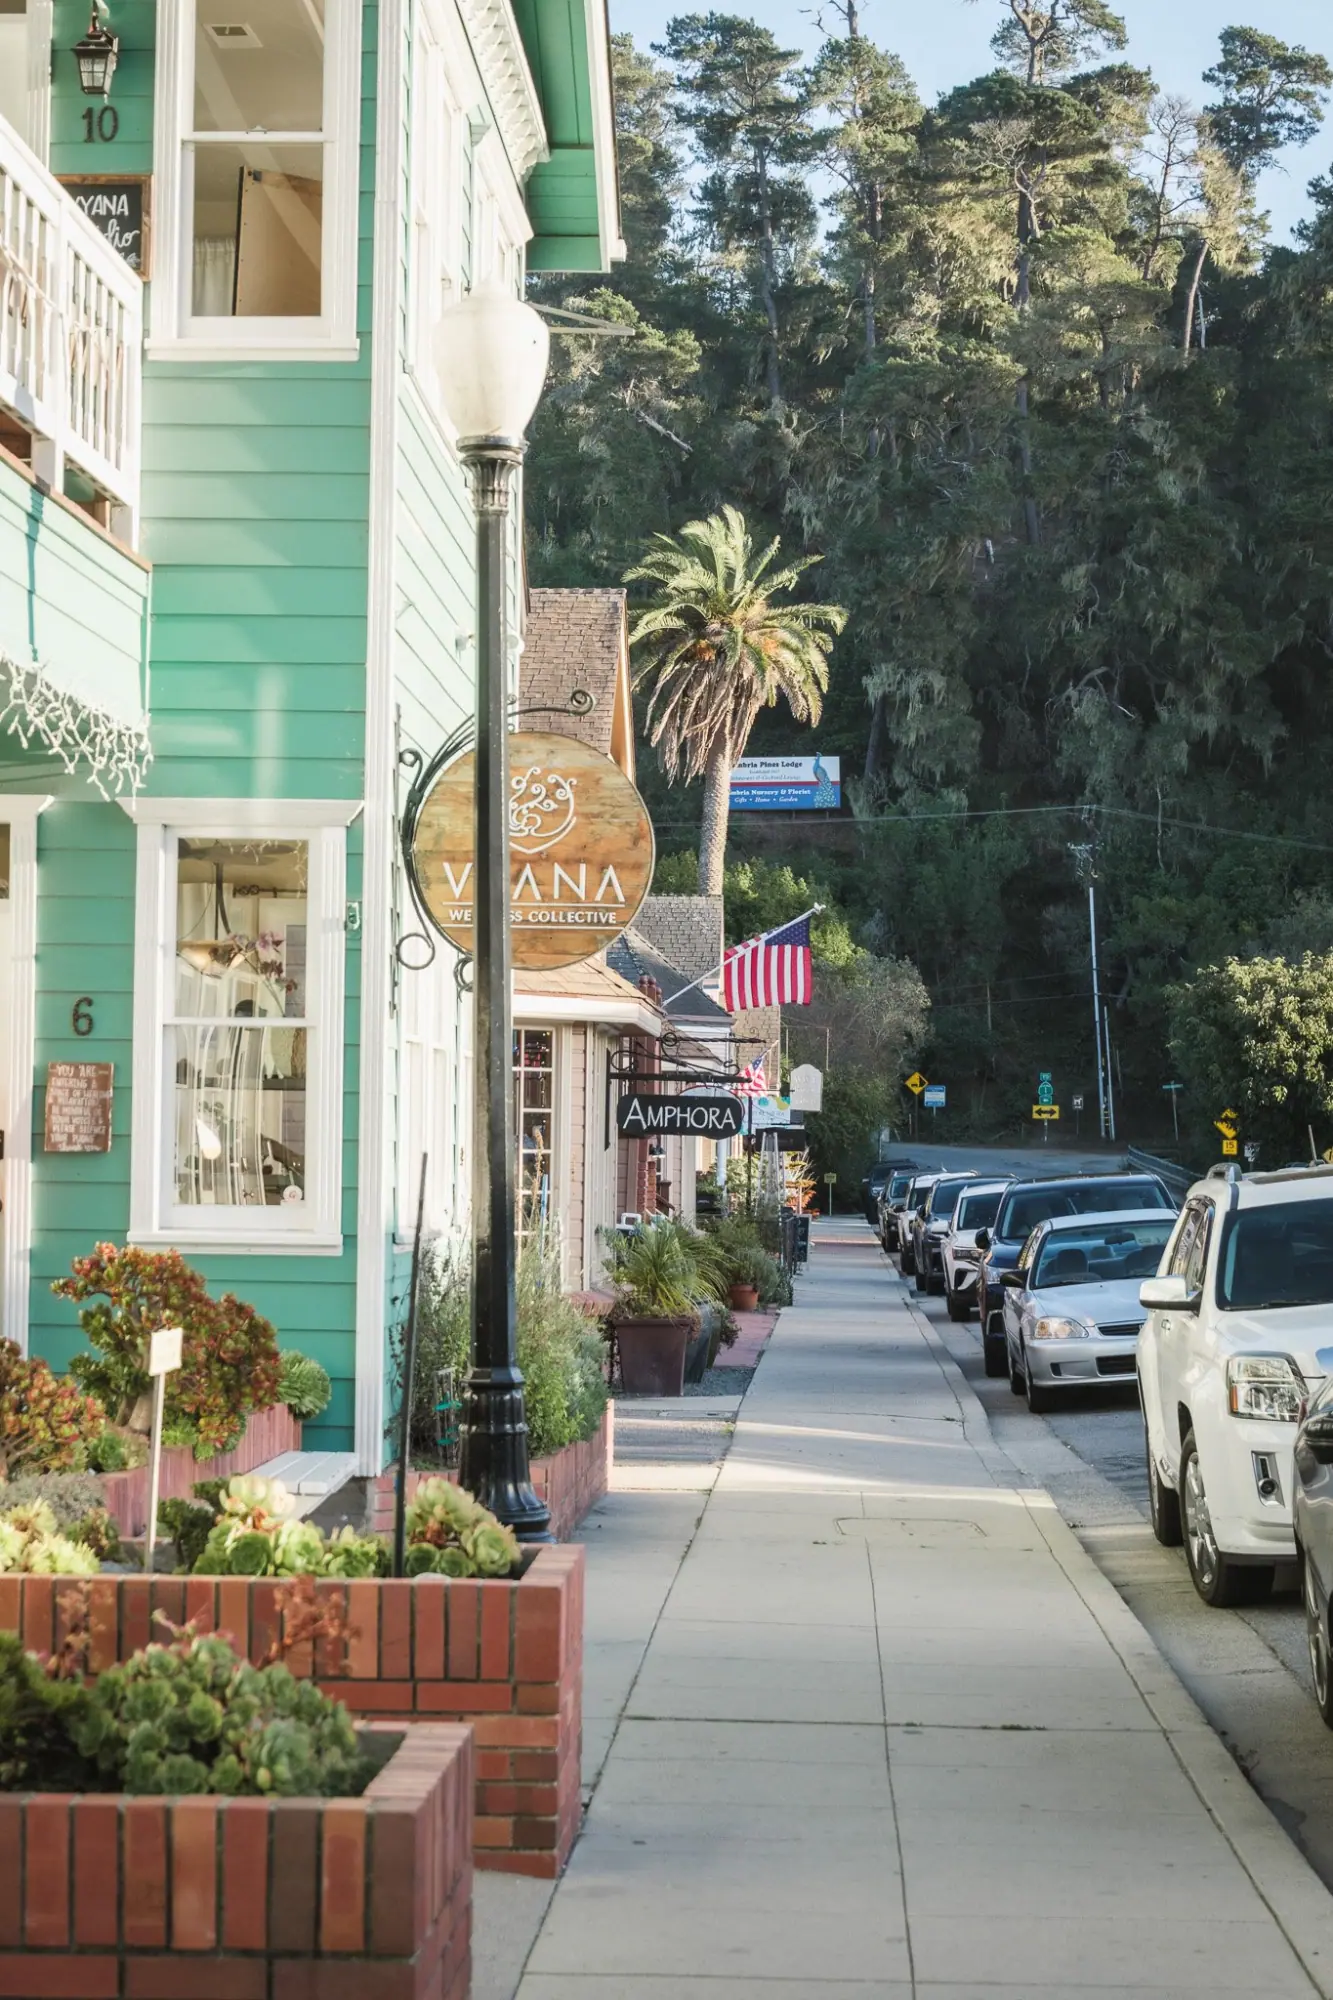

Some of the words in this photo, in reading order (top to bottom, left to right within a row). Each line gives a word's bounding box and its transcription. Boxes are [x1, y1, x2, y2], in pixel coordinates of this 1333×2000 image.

[81, 105, 119, 143] 10
[443, 862, 626, 902] VANA
[449, 909, 523, 922] WESS
[528, 911, 617, 924] COLLECTIVE
[72, 996, 94, 1036] 6
[57, 1064, 75, 1077] YOU
[79, 1064, 97, 1077] ARE
[623, 1098, 736, 1130] AMPHORA
[1225, 1141, 1235, 1149] 15
